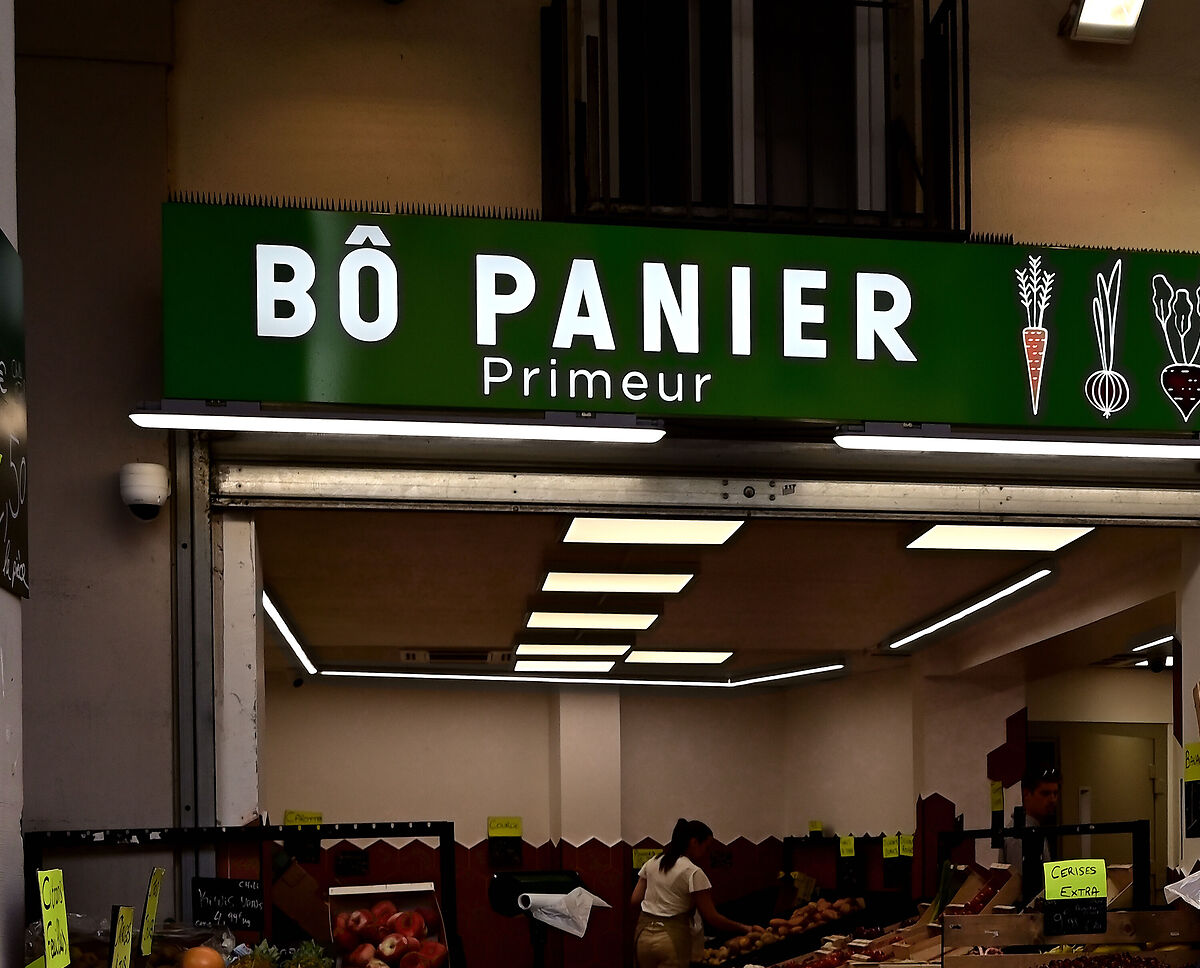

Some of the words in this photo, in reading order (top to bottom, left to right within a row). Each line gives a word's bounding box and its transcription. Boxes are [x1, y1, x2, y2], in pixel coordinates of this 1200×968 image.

[255, 224, 400, 343] BÔ
[474, 254, 919, 363] PANIER
[482, 356, 713, 404] Primeur
[1051, 865, 1097, 879] CERISES
[1060, 886, 1100, 897] EXTRA
